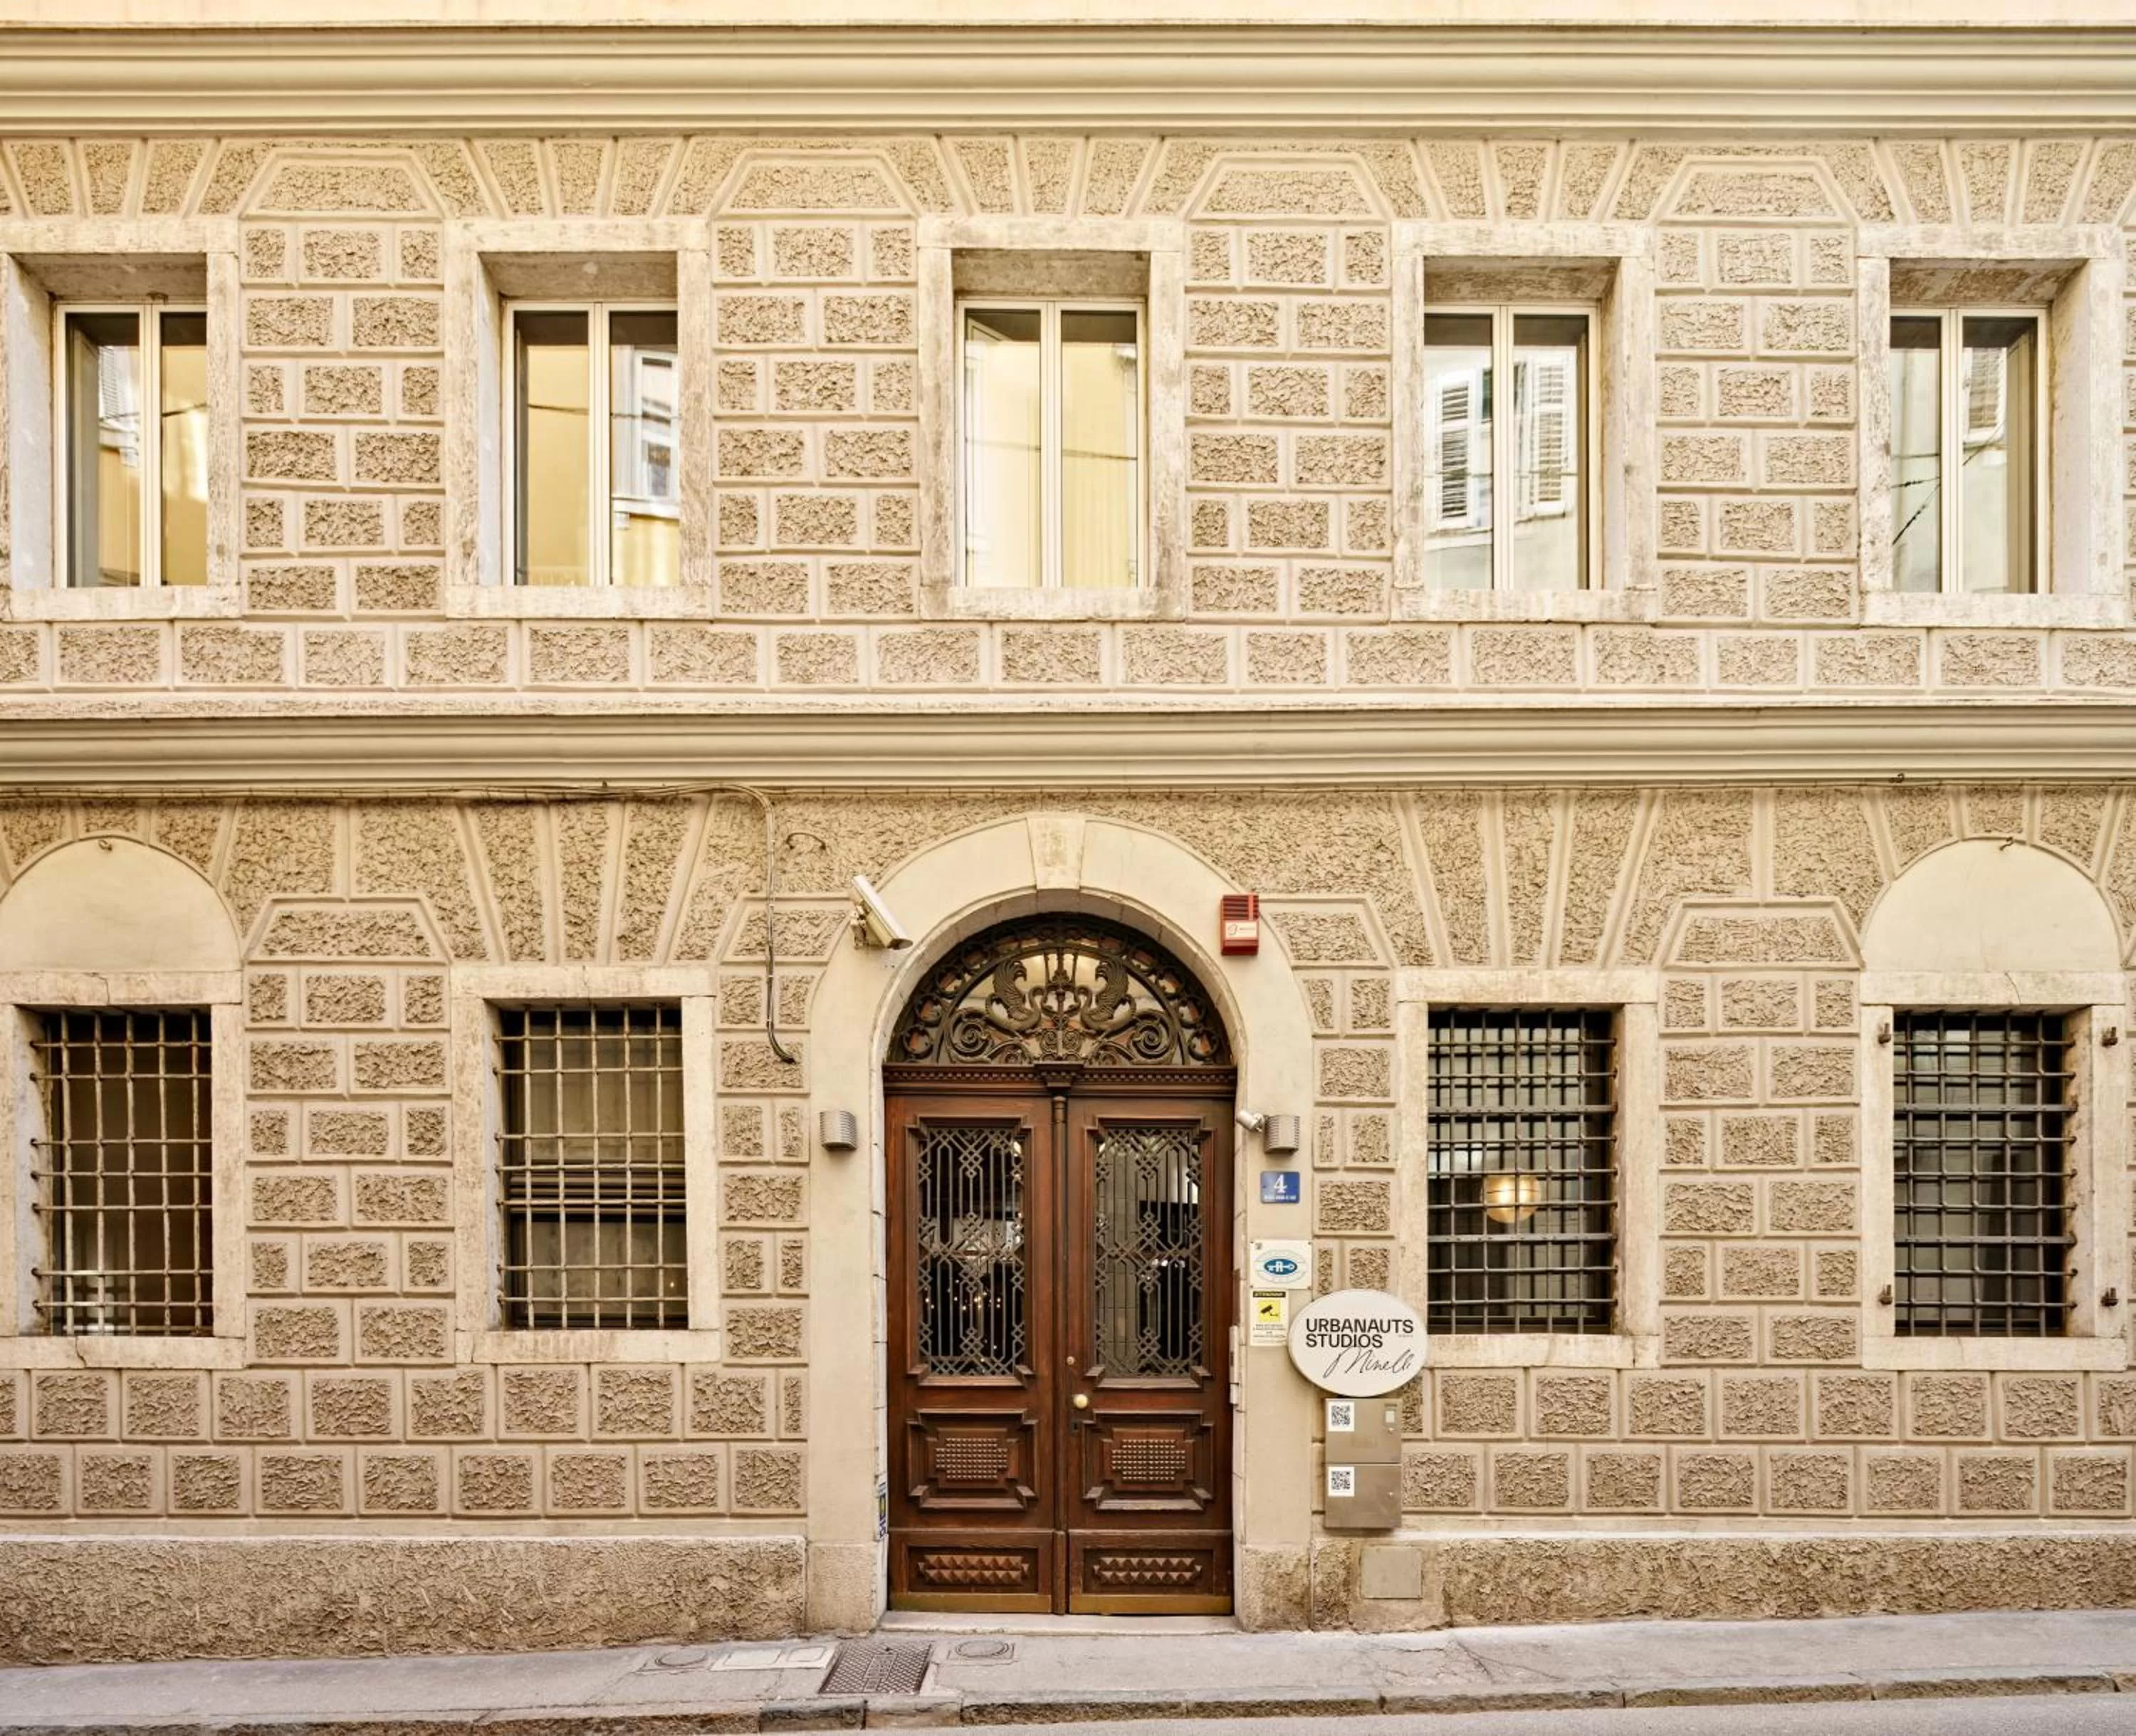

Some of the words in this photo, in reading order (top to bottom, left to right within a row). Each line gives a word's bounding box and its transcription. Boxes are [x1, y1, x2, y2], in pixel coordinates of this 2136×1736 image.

[1274, 1174, 1287, 1193] 4
[1307, 1318, 1413, 1333] URBANAUTS
[1306, 1334, 1383, 1348] STUDIOS
